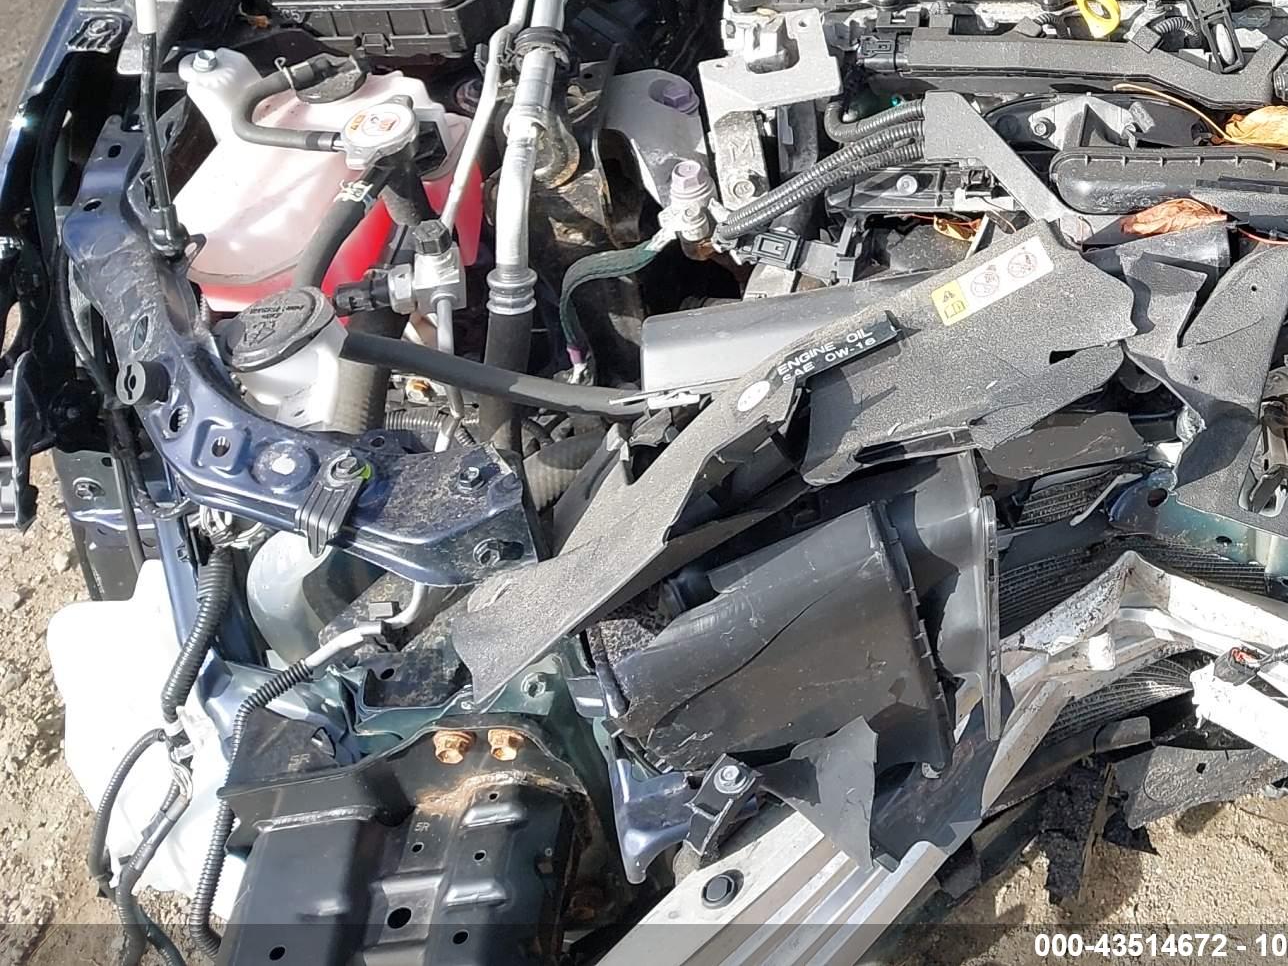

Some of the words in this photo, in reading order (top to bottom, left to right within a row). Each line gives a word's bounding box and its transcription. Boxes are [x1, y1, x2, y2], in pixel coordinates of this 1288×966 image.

[776, 341, 837, 376] ENGINE
[846, 328, 873, 344] OIL
[782, 362, 816, 384] SAE
